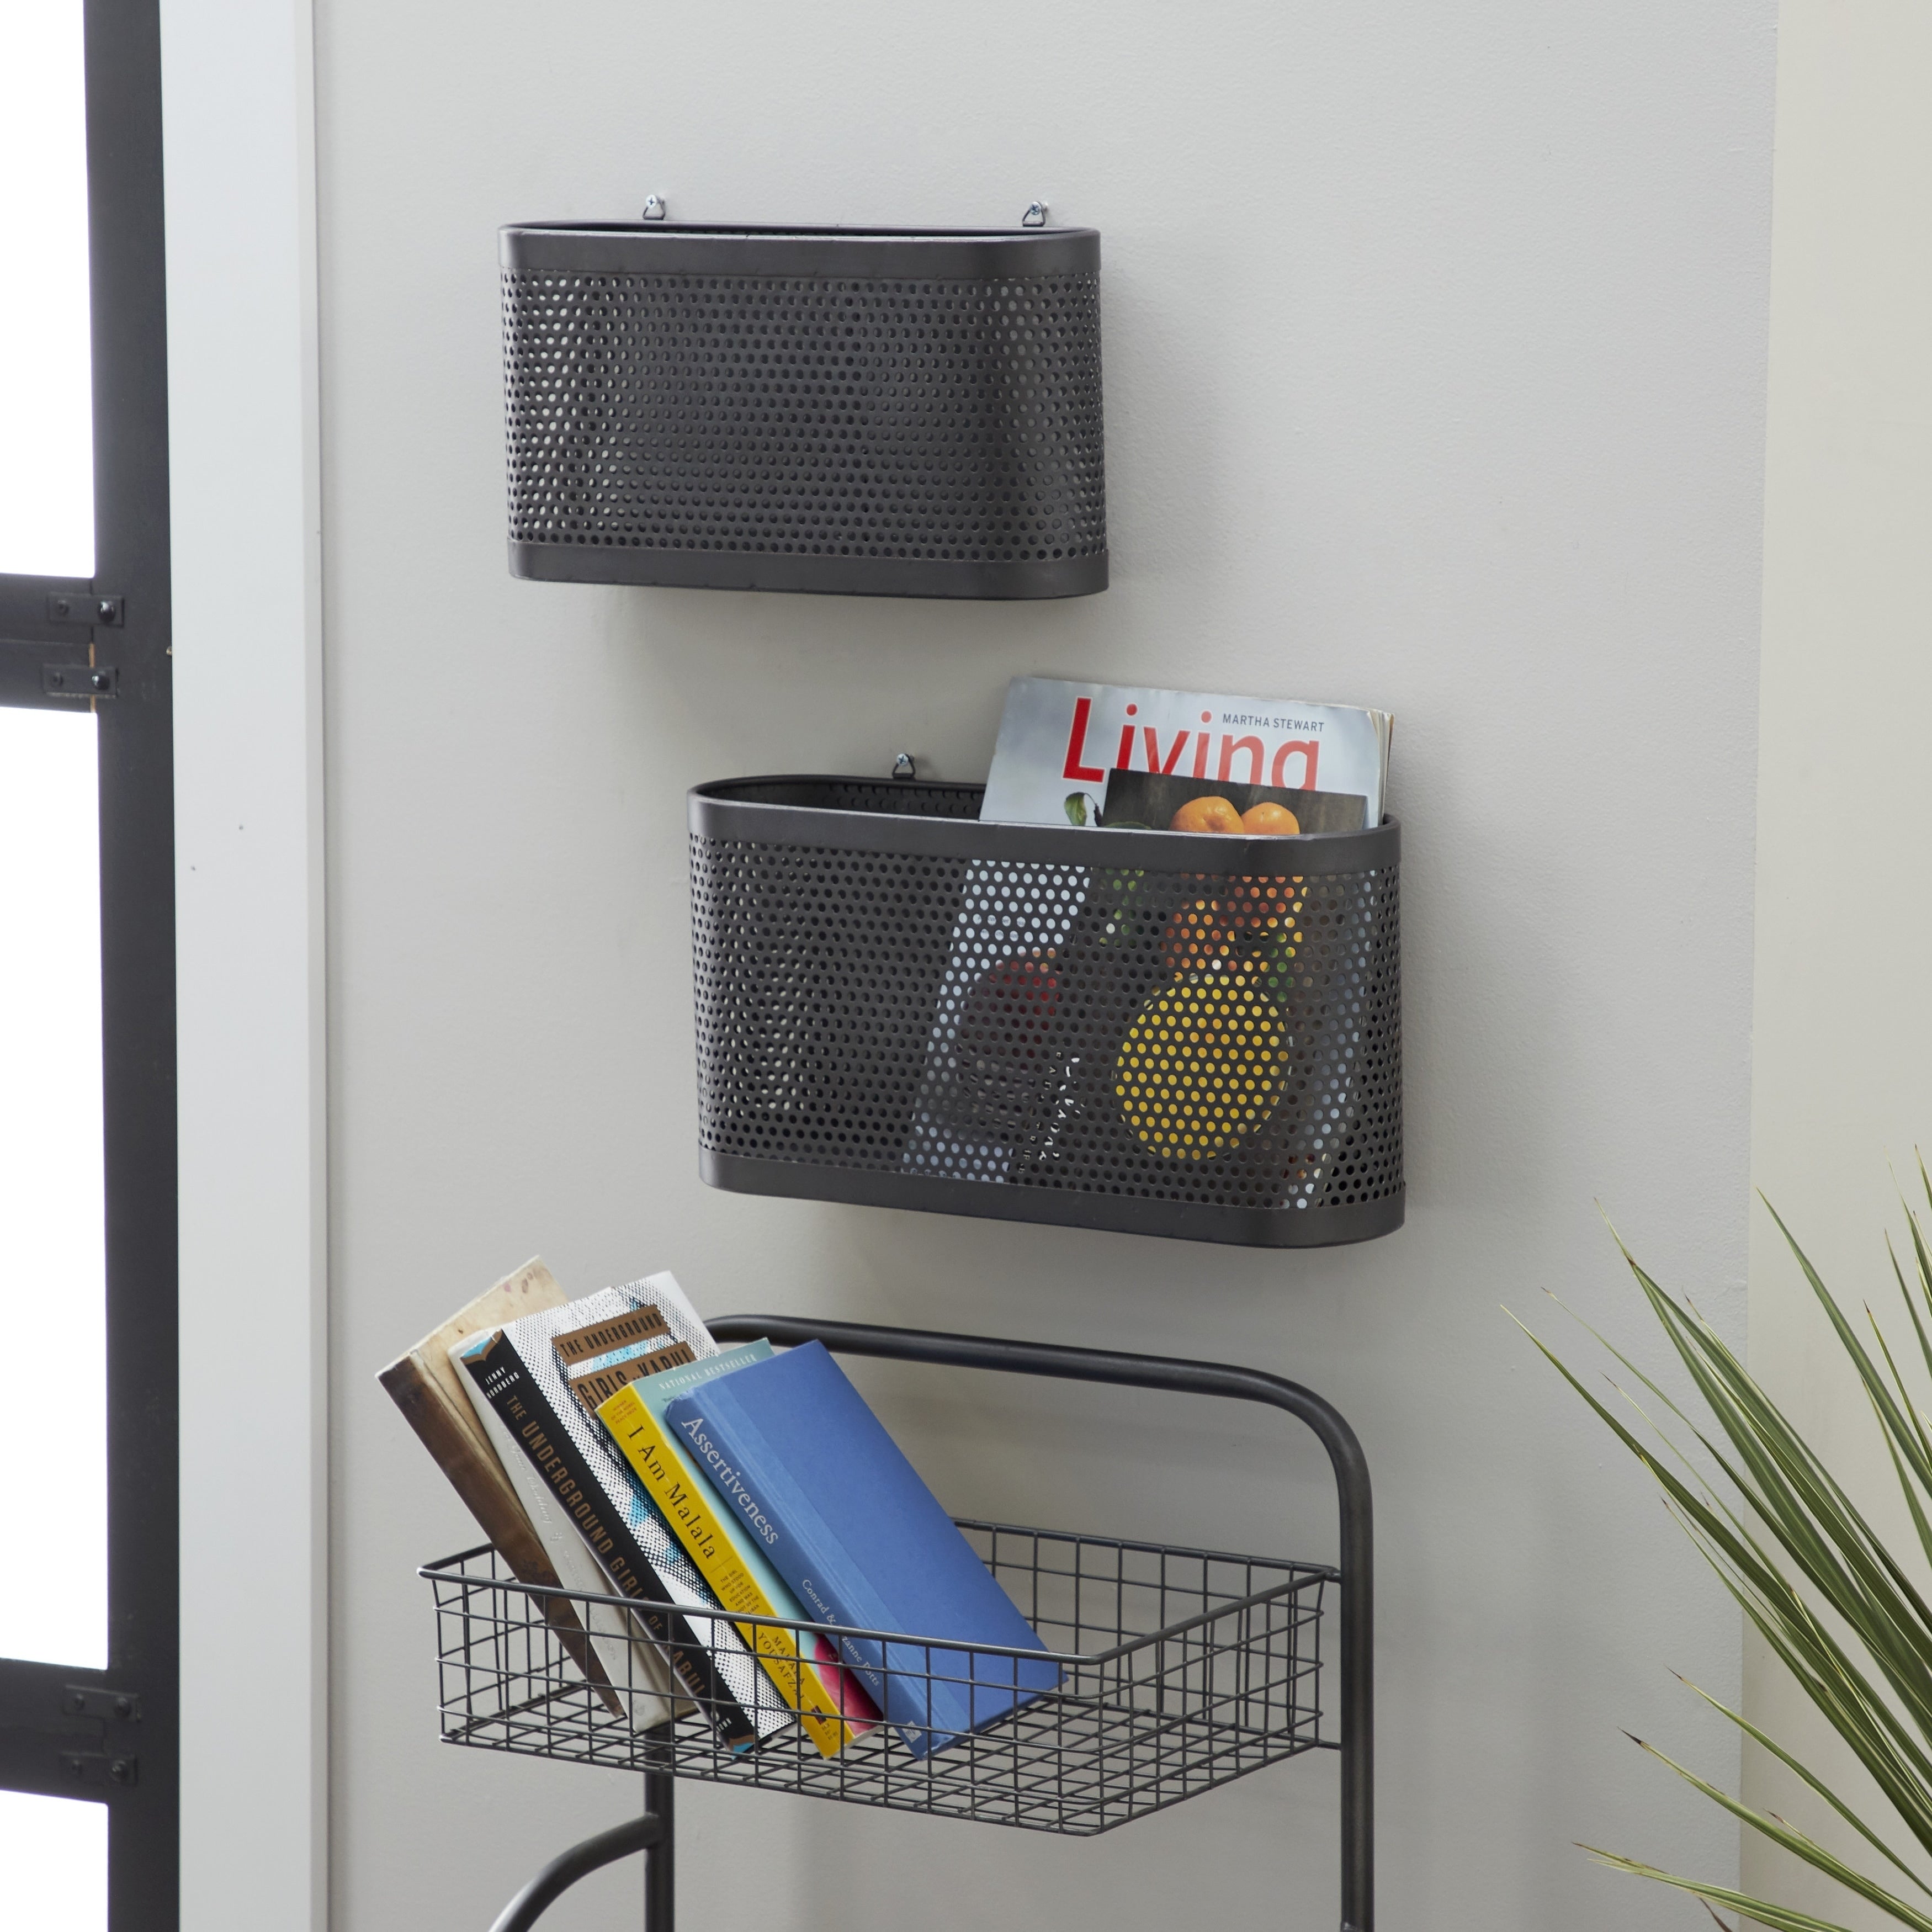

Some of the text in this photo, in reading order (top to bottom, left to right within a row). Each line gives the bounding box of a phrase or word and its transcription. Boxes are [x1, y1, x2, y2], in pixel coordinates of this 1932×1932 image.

[1222, 713, 1325, 732] MARTHA STEWART
[560, 1313, 663, 1358] THE UNDERGROUND
[485, 1366, 506, 1385] JENNY
[486, 1371, 520, 1399] NORDBERG
[659, 1354, 758, 1390] NATIONAL BESTSELLER
[627, 1424, 715, 1559] I Am Malala
[681, 1417, 778, 1544] Assertiveness
[506, 1395, 527, 1420] THE
[522, 1420, 614, 1554] UNDERGROUND
[649, 1615, 662, 1630] OF
[729, 1585, 751, 1602] EDUCATION
[731, 1573, 744, 1584] STOOD
[744, 1591, 753, 1600] WAS
[802, 1579, 879, 1686] Conrad & zanne Potts
